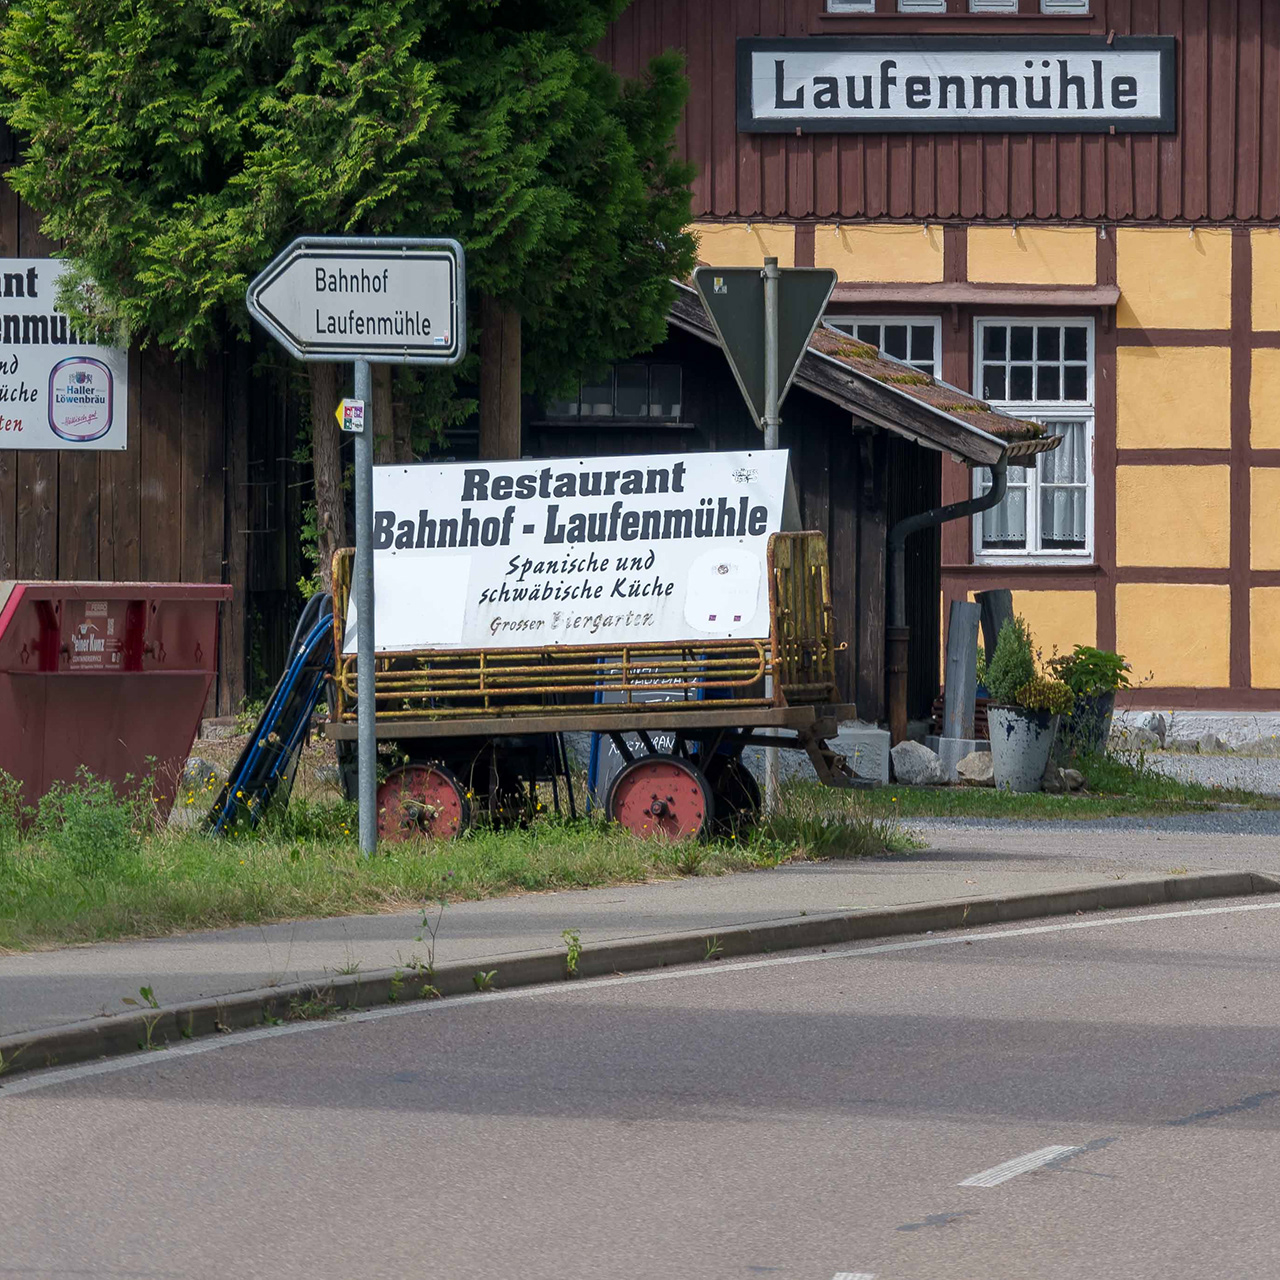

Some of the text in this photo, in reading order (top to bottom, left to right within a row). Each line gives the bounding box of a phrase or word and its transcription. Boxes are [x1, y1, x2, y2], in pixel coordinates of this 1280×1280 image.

[774, 59, 1138, 110] Laufenmühle
[315, 268, 388, 293] Bahnhof
[315, 308, 431, 337] Laufenmühle
[55, 394, 106, 404] Löwenbräu
[66, 386, 96, 395] Haller
[461, 461, 687, 502] Restaurant
[374, 505, 515, 549] Bahnhof
[543, 497, 768, 544] Laufenmühle
[507, 549, 655, 582] Spanische und
[479, 577, 674, 605] schwäbische Küche
[490, 616, 545, 636] Grosser
